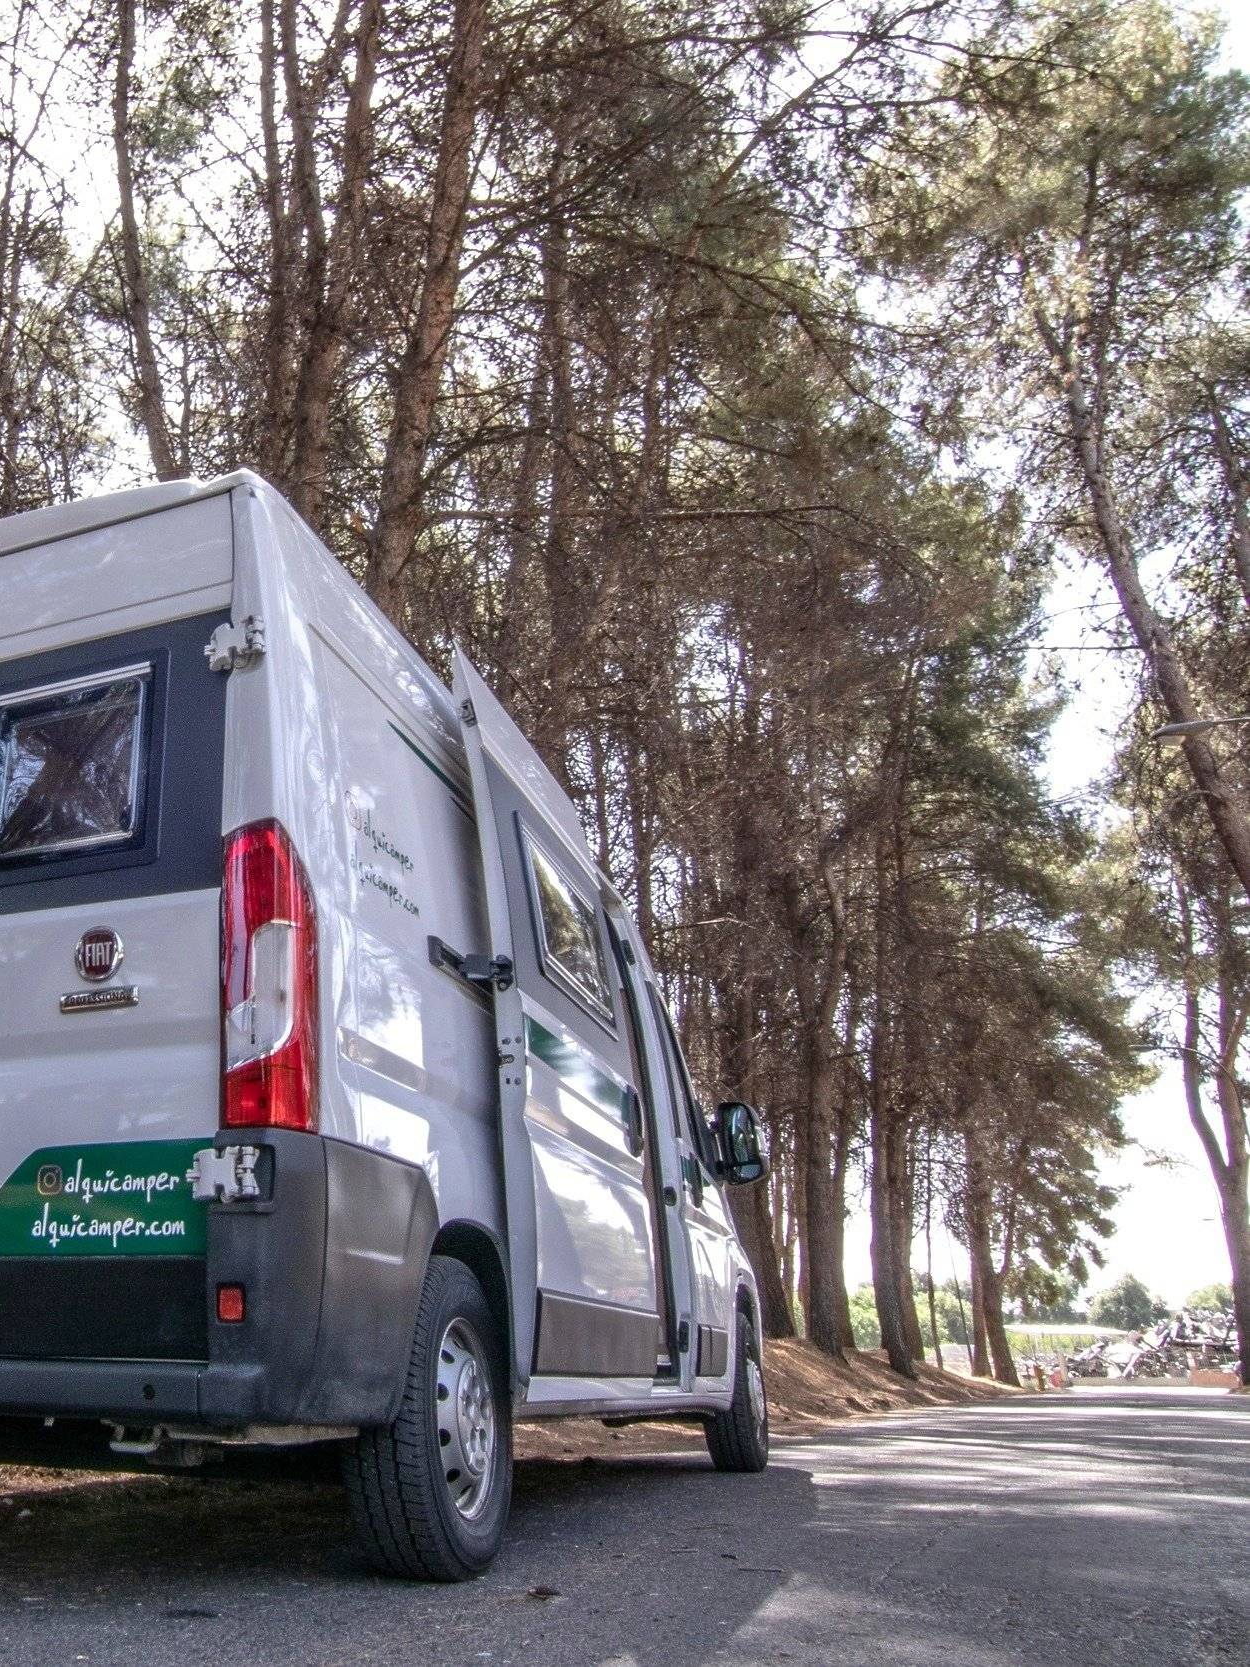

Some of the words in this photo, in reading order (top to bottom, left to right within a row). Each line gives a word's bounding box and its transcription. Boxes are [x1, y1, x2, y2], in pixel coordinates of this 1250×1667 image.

[85, 941, 112, 967] FIAT
[65, 1158, 180, 1204] alquicamper
[31, 1202, 186, 1248] alquicamper.com
